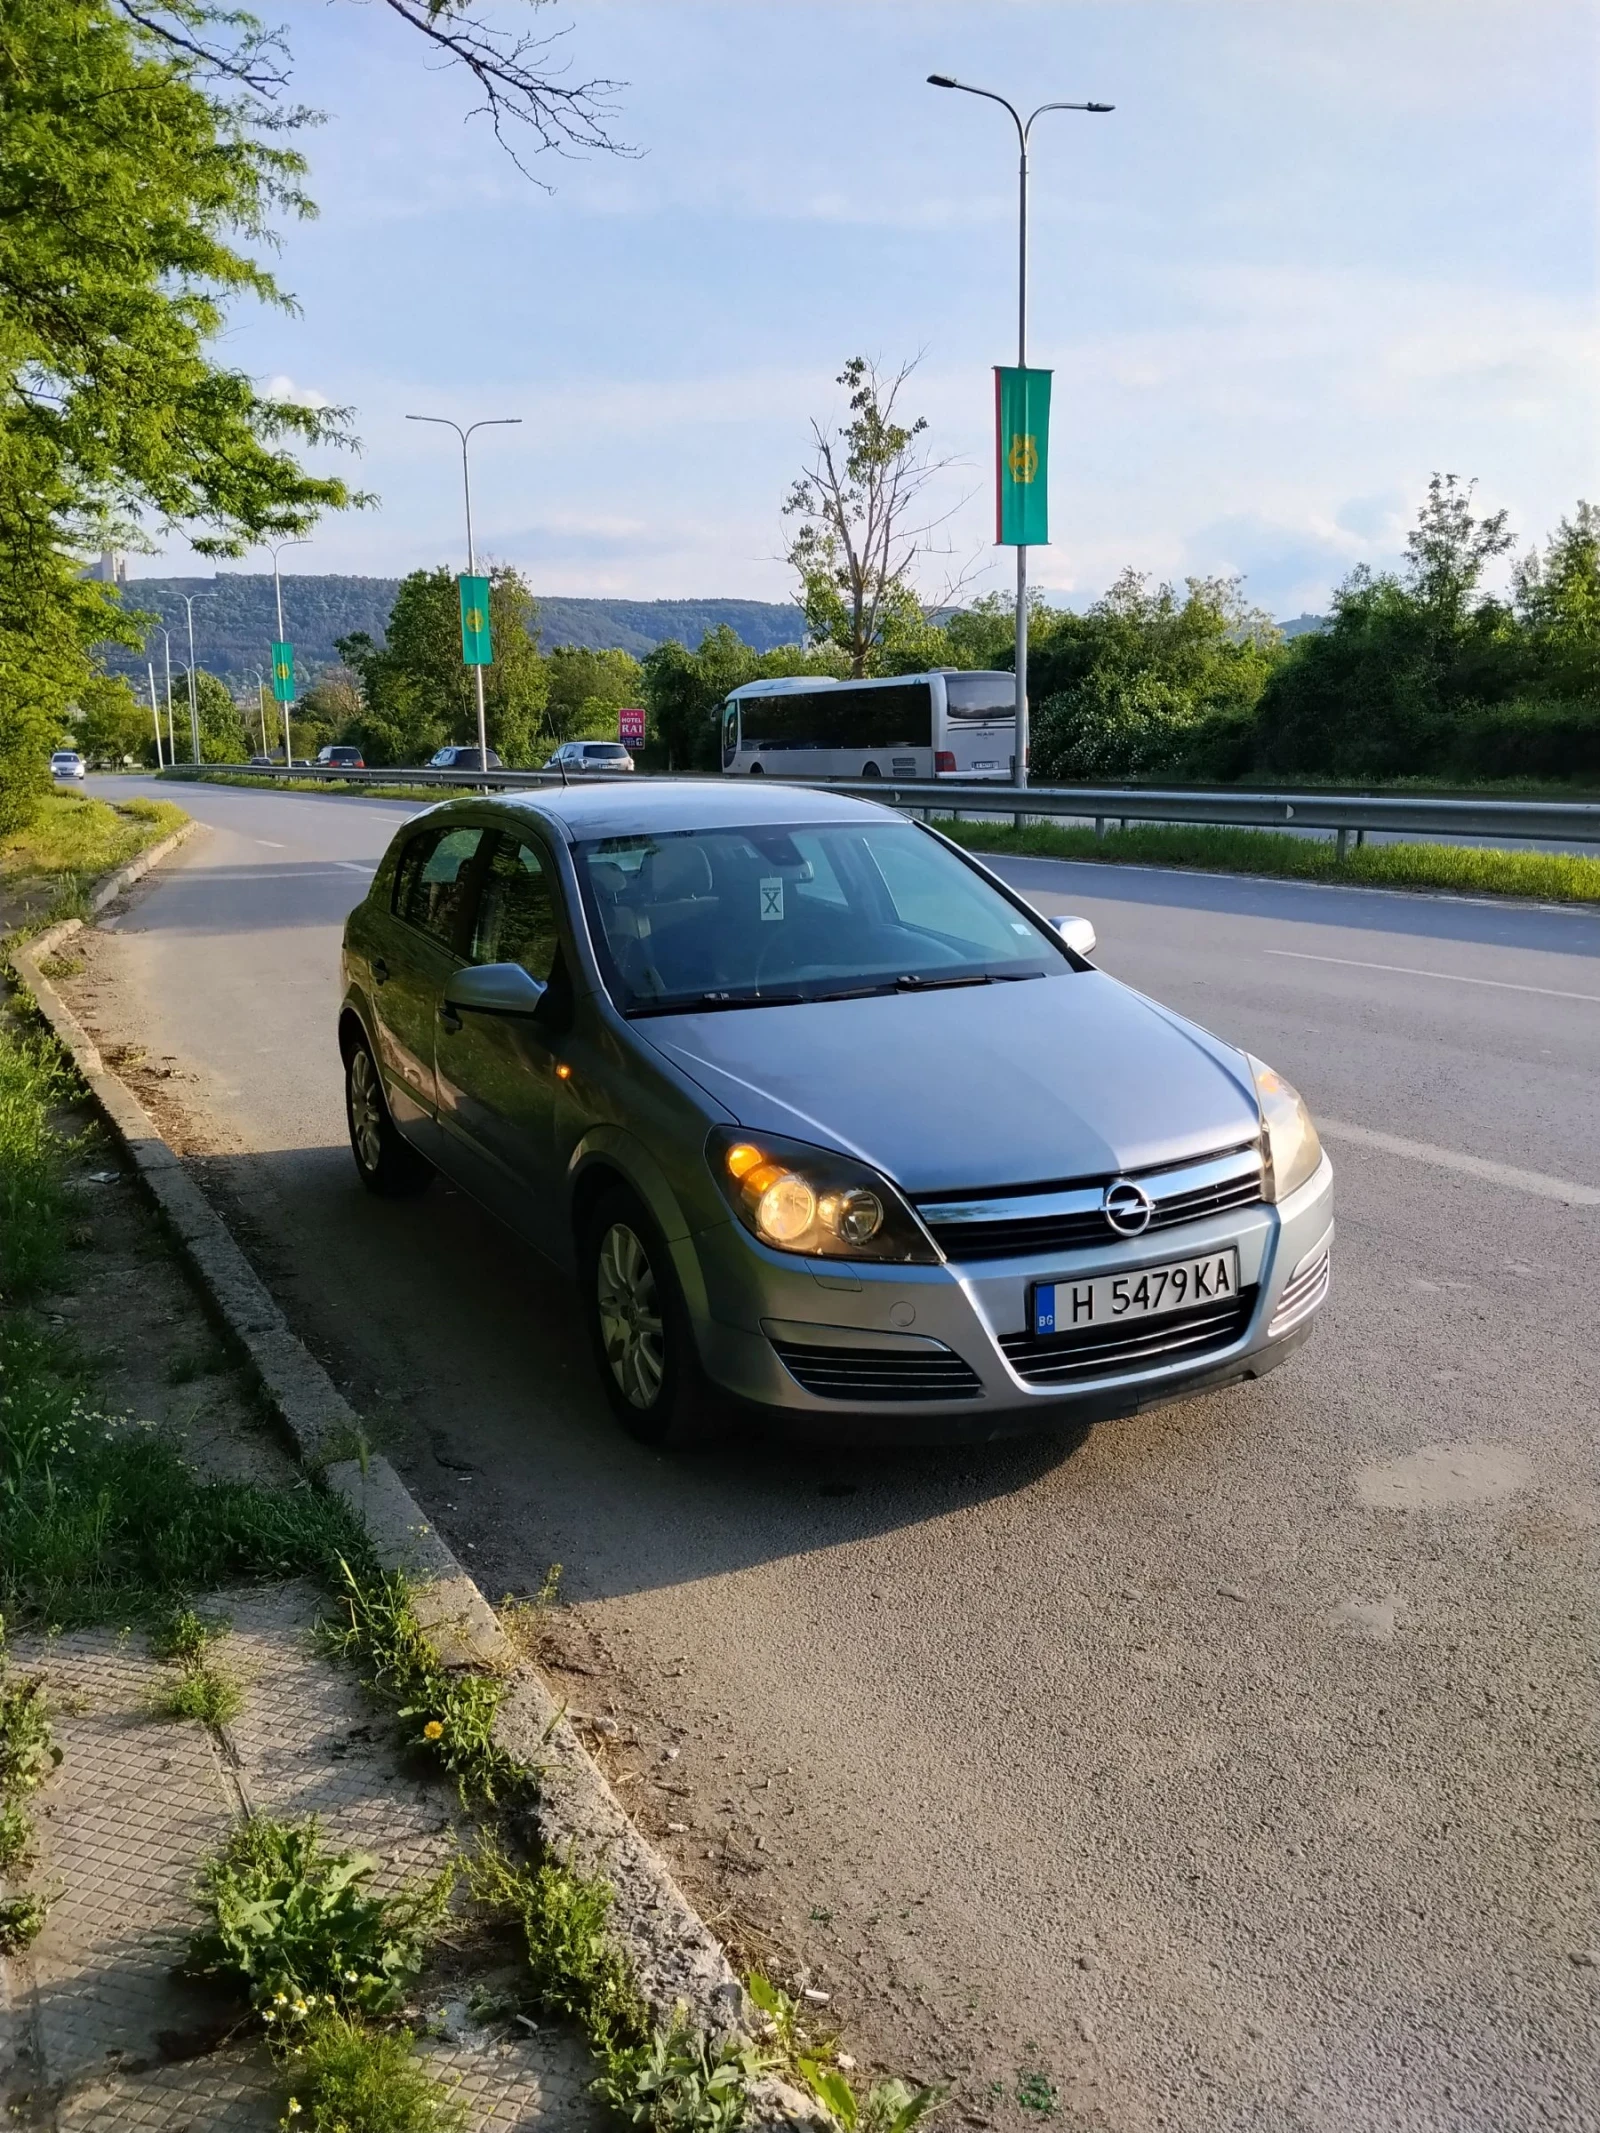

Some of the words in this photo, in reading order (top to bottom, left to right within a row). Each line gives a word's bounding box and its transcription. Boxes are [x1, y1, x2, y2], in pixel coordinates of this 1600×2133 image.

[622, 724, 642, 733] RAI
[762, 892, 781, 913] X
[1072, 1284, 1094, 1323] H
[1038, 1314, 1054, 1327] BG
